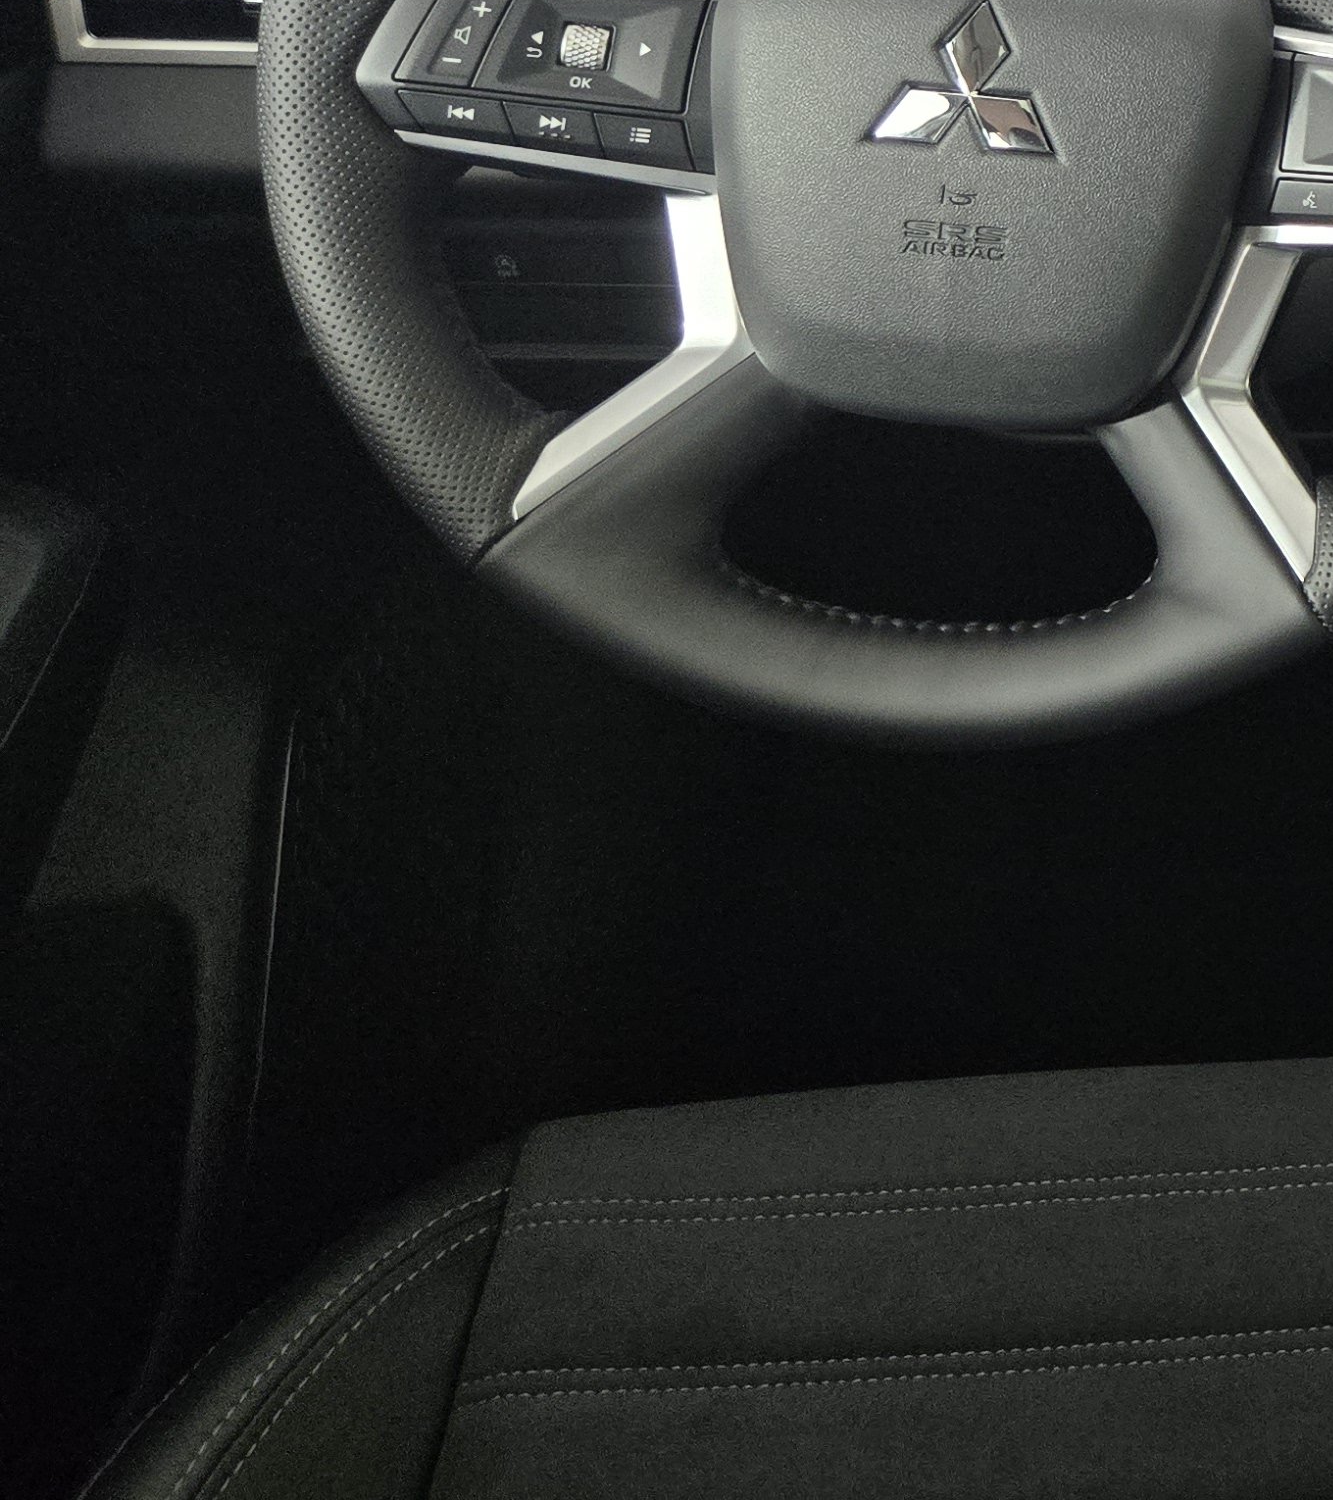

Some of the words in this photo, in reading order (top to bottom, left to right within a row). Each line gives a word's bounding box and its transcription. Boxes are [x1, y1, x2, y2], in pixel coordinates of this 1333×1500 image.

[569, 76, 593, 89] OK
[903, 219, 1009, 245] SRS
[900, 239, 1007, 261] AIRBAG
